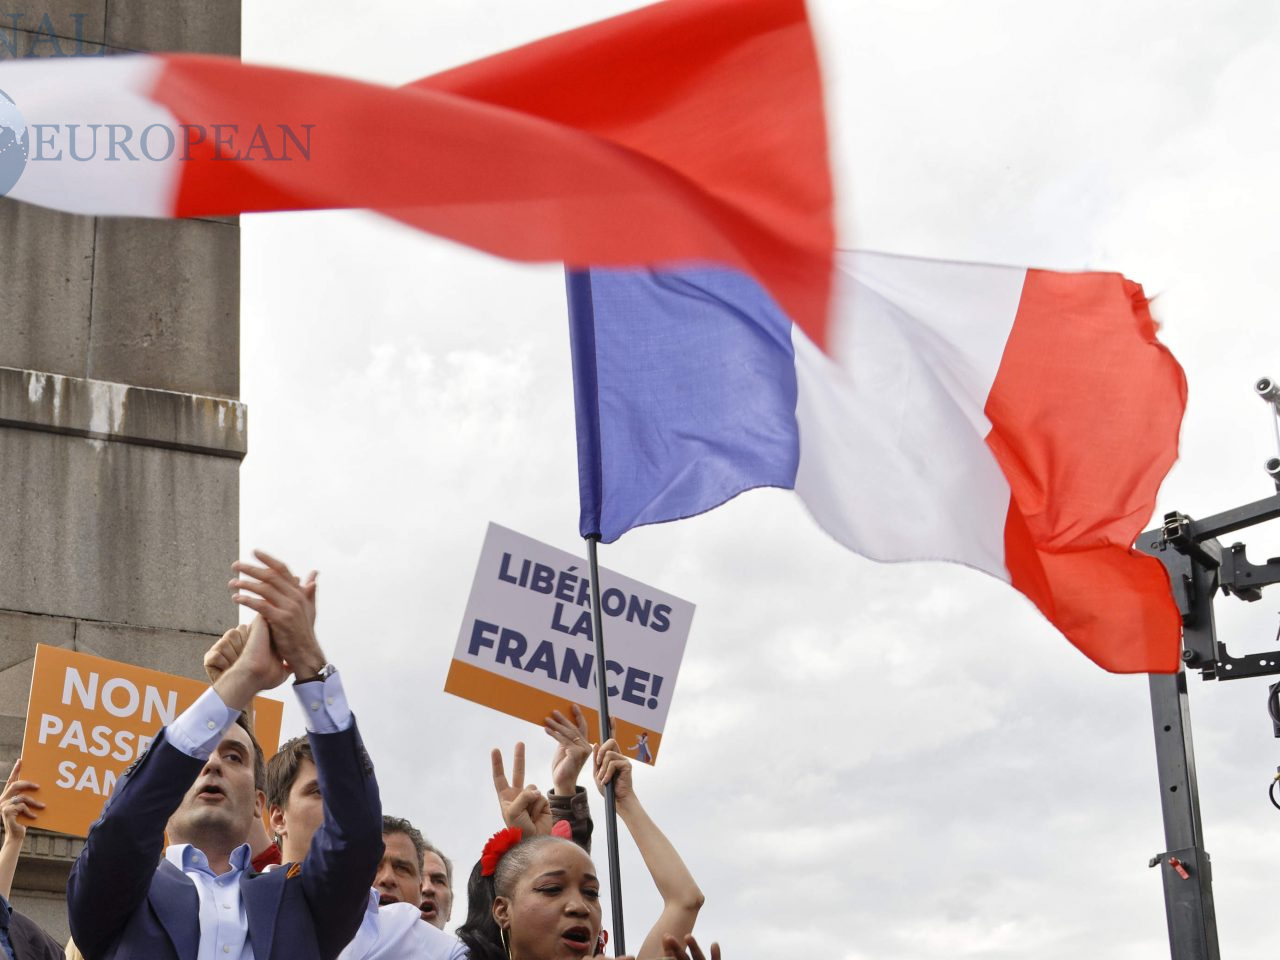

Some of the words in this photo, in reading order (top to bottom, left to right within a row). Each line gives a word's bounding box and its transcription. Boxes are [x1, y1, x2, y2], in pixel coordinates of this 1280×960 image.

[551, 602, 594, 642] LA
[467, 618, 665, 710] FRANCE!
[61, 666, 178, 727] NON
